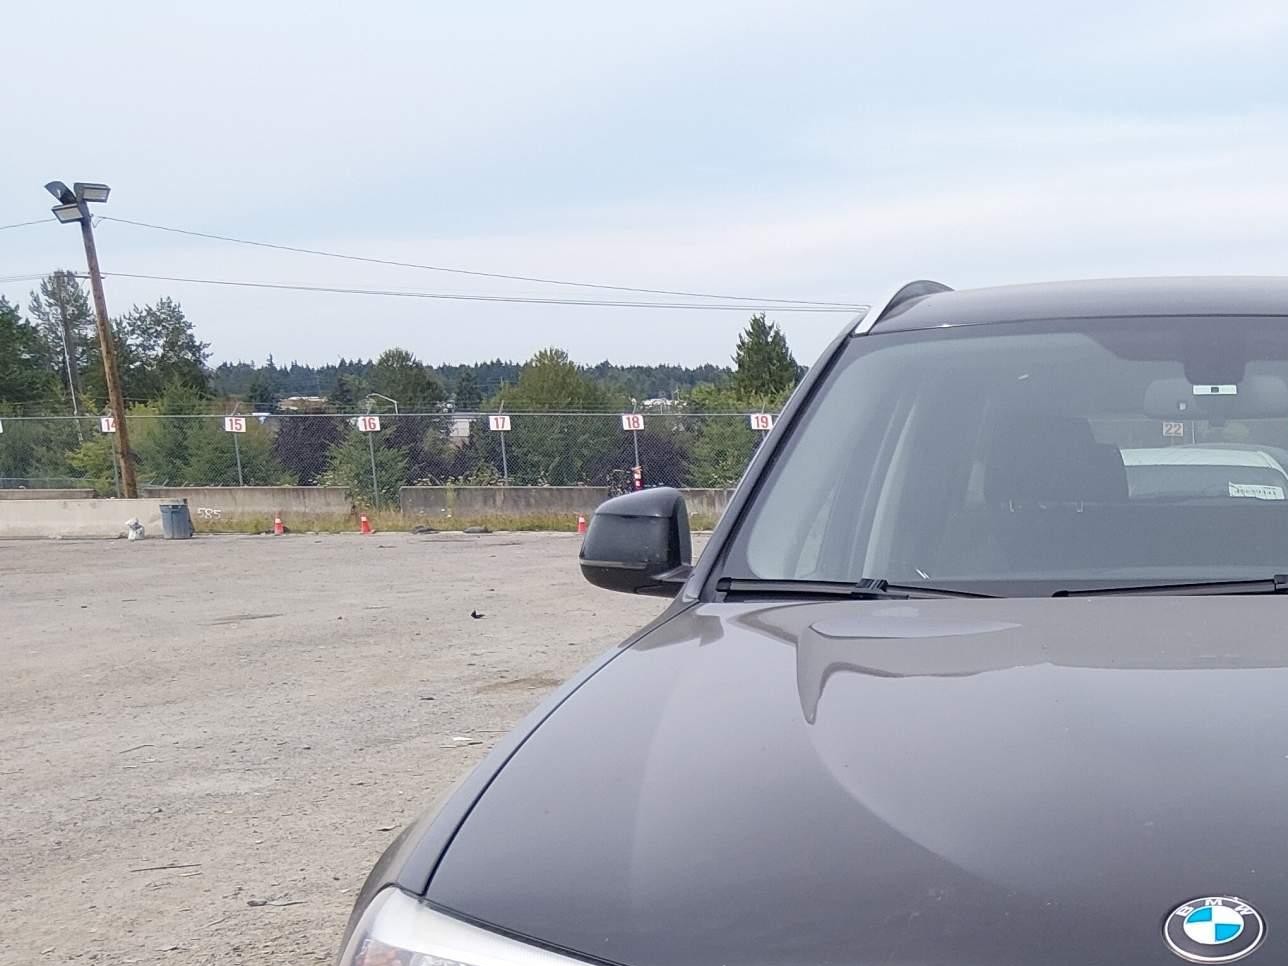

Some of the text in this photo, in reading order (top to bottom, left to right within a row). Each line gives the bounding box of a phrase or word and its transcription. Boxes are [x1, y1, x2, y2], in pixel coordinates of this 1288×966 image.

[229, 418, 242, 431] 15
[362, 417, 377, 431] 16
[494, 416, 506, 429] 17
[626, 415, 640, 429] 18
[755, 415, 769, 429] 19
[1163, 423, 1182, 434] 22
[1175, 899, 1254, 917] BMW
